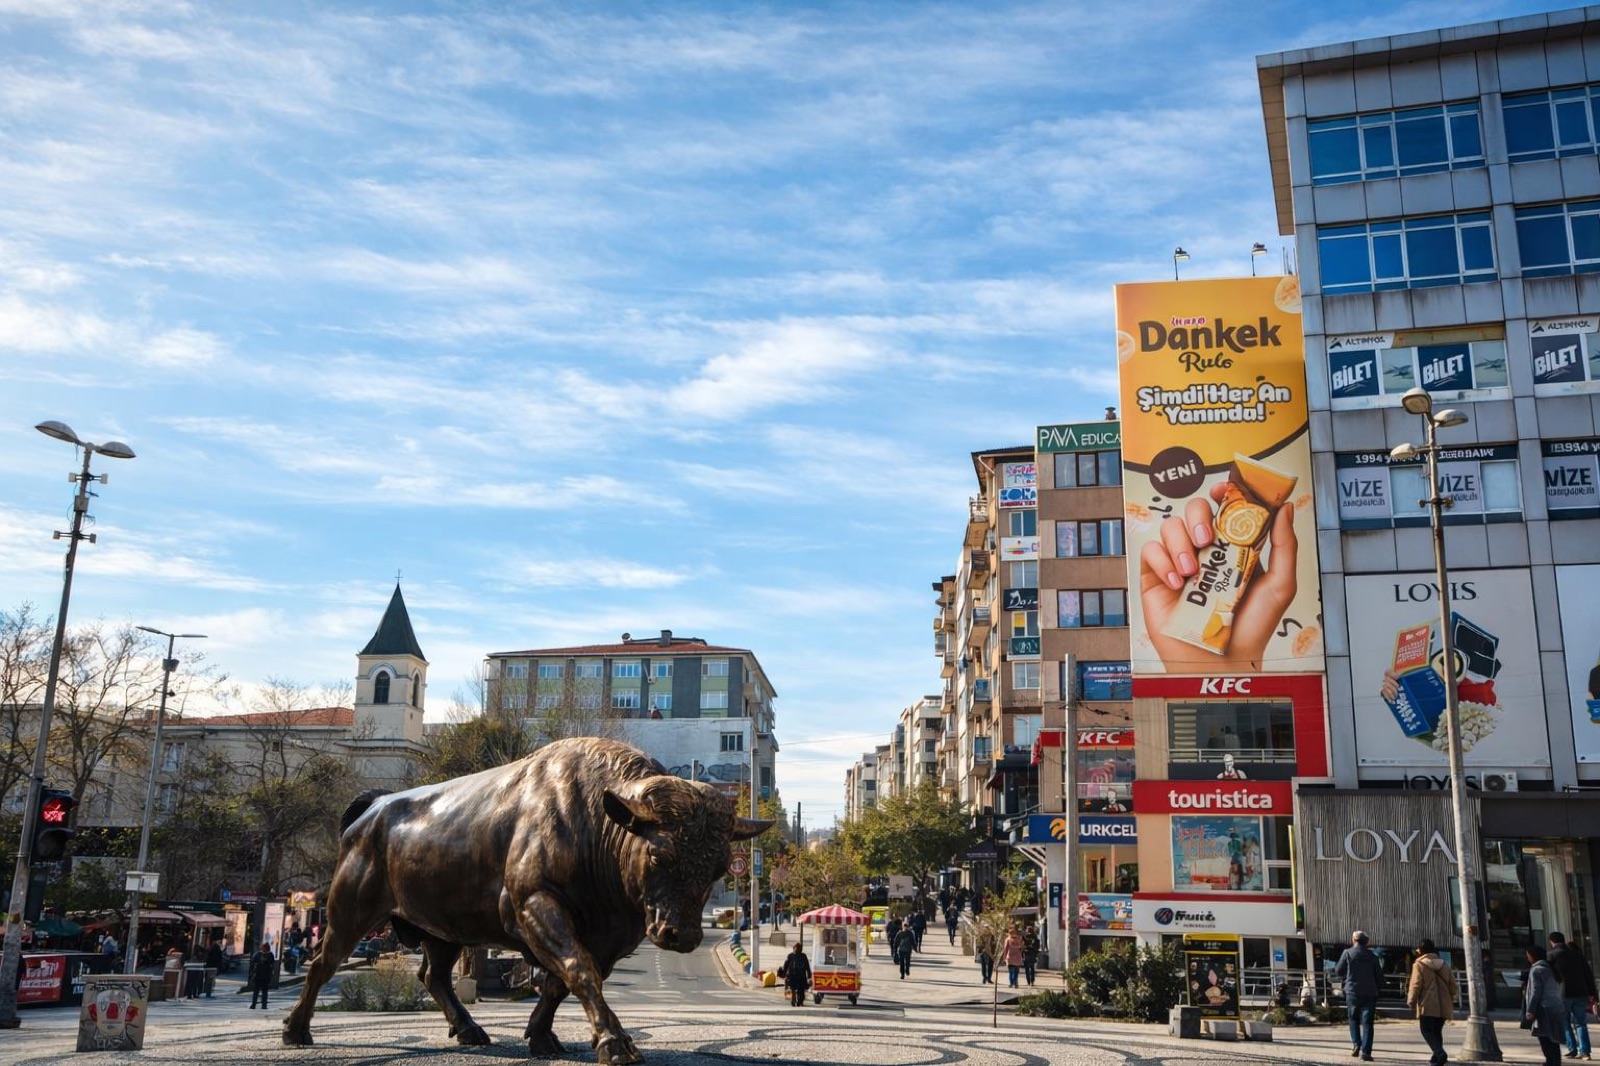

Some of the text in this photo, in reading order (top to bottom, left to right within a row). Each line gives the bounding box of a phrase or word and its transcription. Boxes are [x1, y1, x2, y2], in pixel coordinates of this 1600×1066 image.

[1139, 317, 1282, 353] Dankek
[1178, 351, 1234, 373] Rulo
[1422, 353, 1465, 385] BİLET
[1534, 344, 1578, 377] BİLET
[1332, 360, 1373, 391] BİLET
[1039, 427, 1079, 449] PAVA
[1355, 454, 1383, 464] 1994
[1153, 459, 1198, 483] YENİ
[1340, 478, 1384, 498] VİZE
[1186, 538, 1231, 607] Dankek
[1199, 677, 1252, 695] KFC
[1077, 731, 1120, 745] KFC
[1167, 788, 1273, 809] touristica
[1079, 823, 1138, 837] URKCEL
